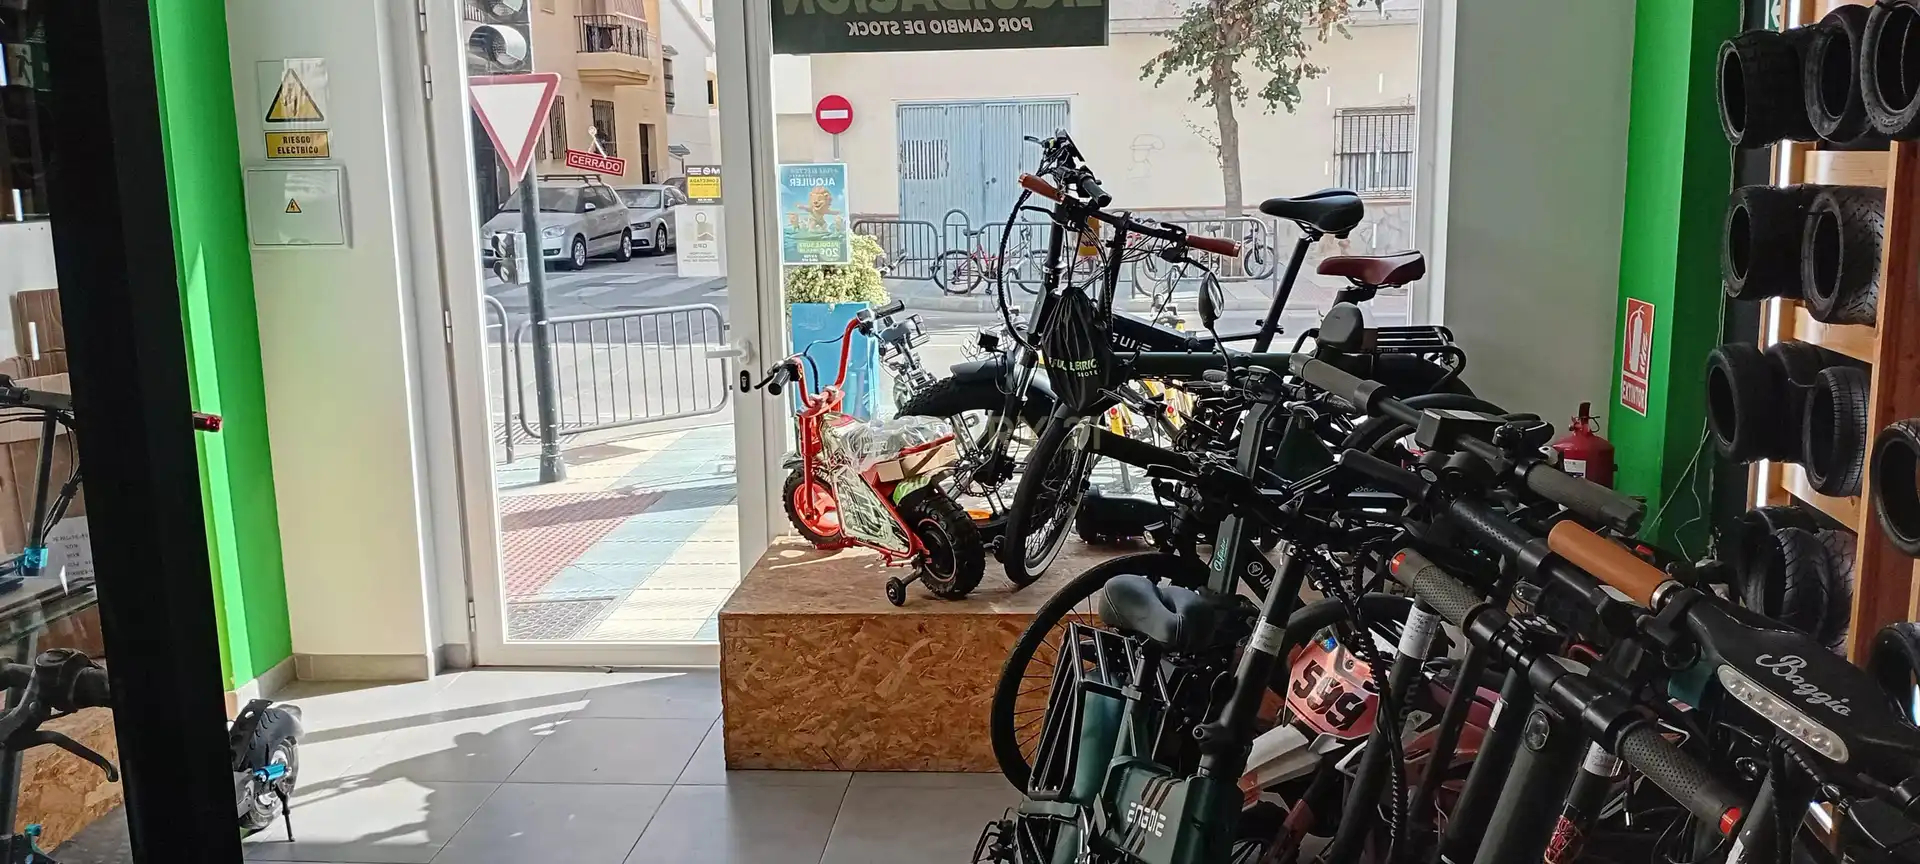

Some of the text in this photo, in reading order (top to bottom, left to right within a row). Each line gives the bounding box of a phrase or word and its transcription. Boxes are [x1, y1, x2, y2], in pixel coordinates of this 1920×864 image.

[282, 136, 311, 144] RIESGO
[571, 154, 620, 172] CERRADO
[1293, 659, 1368, 731] 599
[1755, 653, 1852, 717] Baggio
